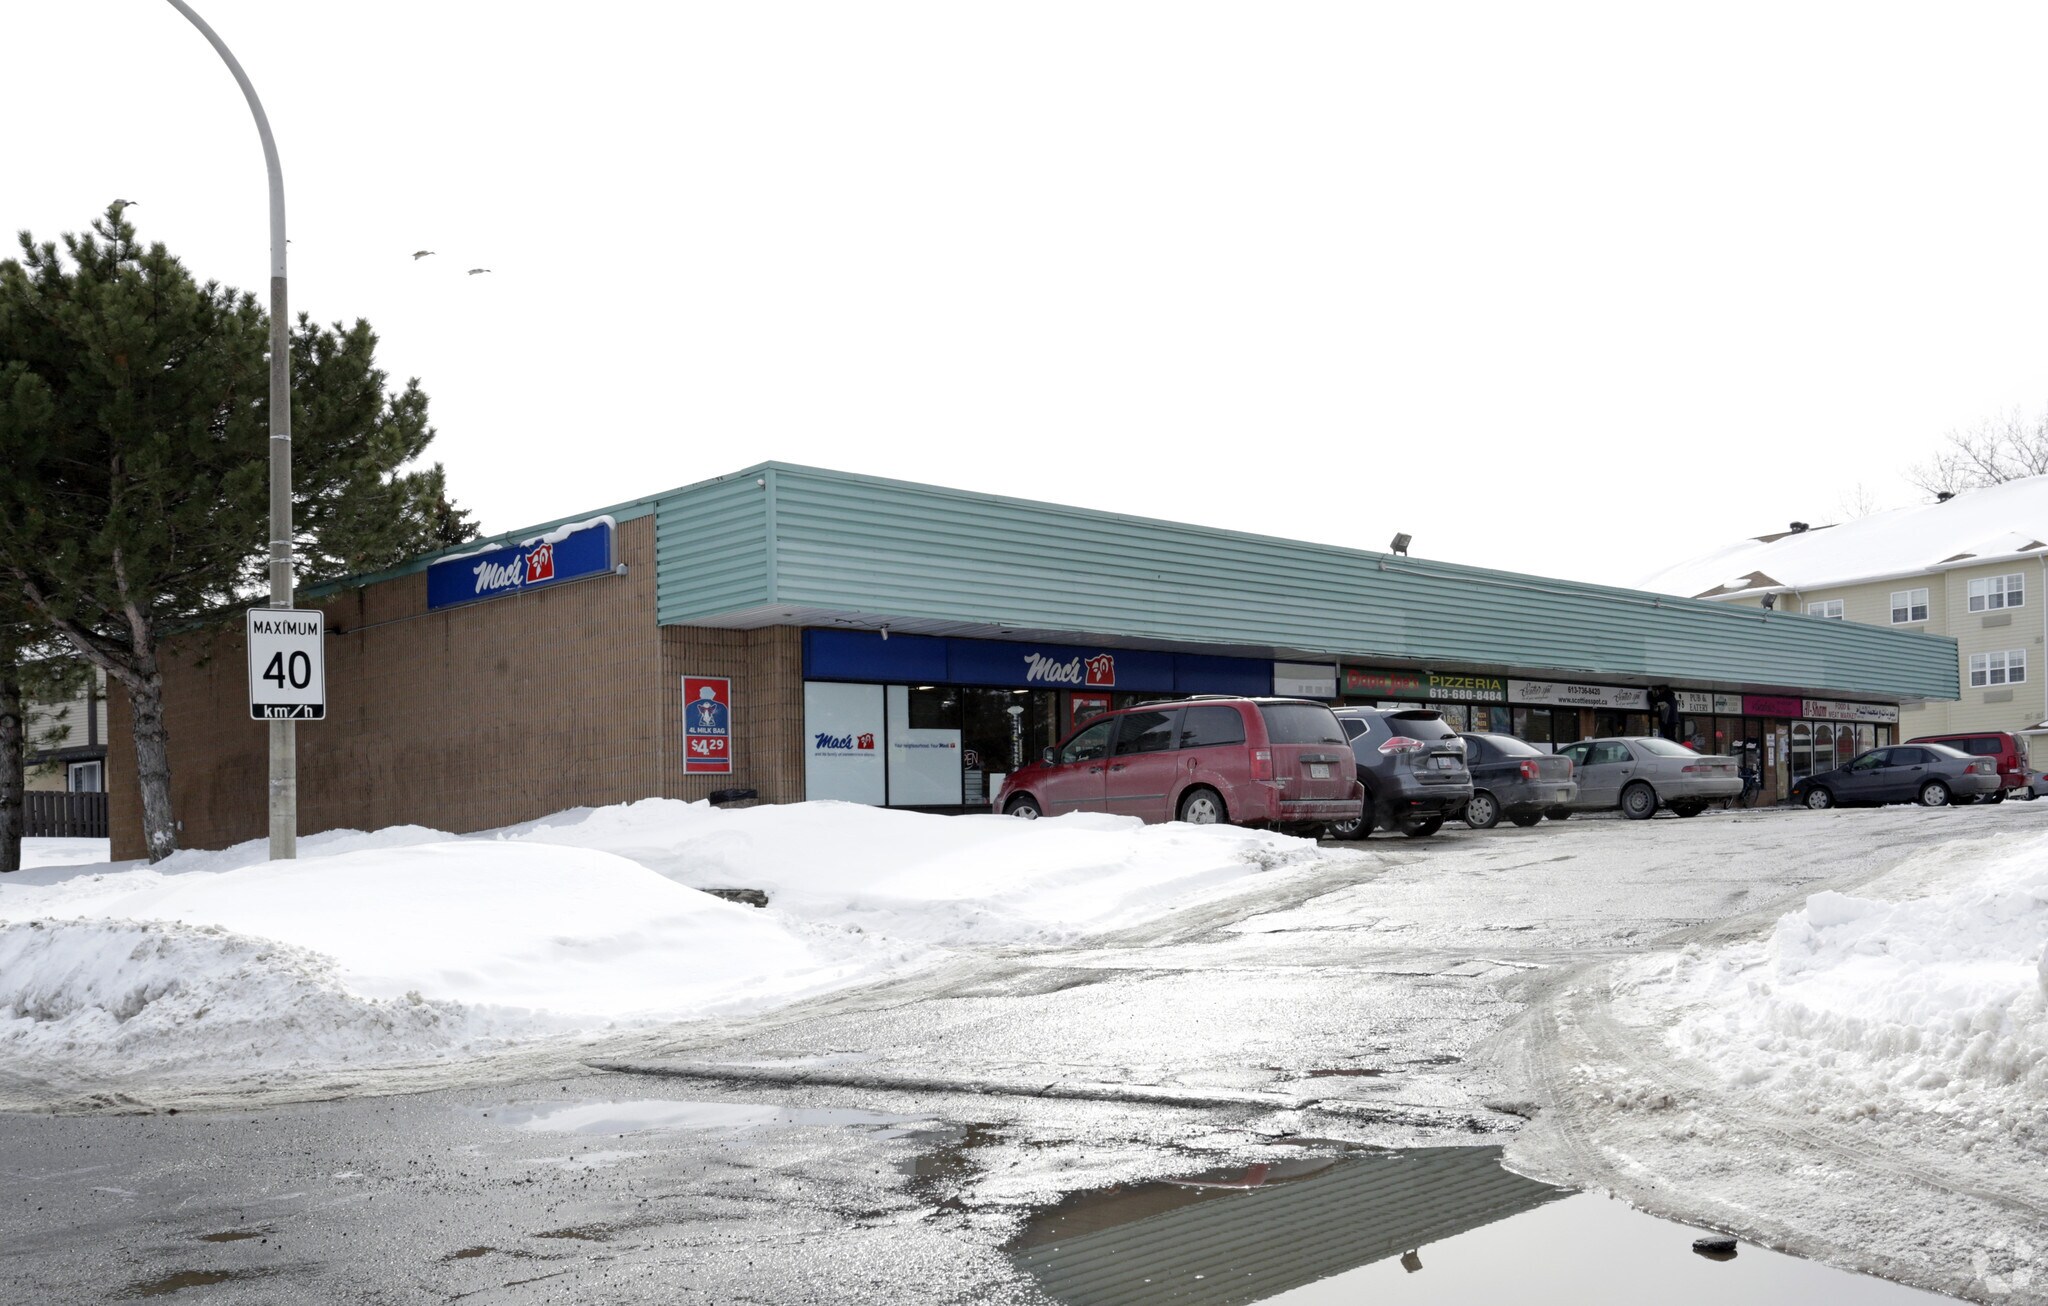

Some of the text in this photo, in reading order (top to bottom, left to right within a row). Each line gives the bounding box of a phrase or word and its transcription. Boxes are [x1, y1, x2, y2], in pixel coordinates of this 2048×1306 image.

[473, 554, 523, 594] Mac's
[253, 620, 318, 636] MAXIMUM
[262, 650, 312, 690] 40
[1023, 652, 1082, 684] Mac's
[1429, 675, 1501, 691] PIZZERIA
[1429, 687, 1502, 701] 613-680-8484
[1689, 693, 1701, 702] PUB
[1689, 703, 1708, 712] EATERY
[1835, 702, 1846, 711] FOOD
[1829, 711, 1857, 720] MEAT MARKET
[814, 732, 854, 750] Mac's
